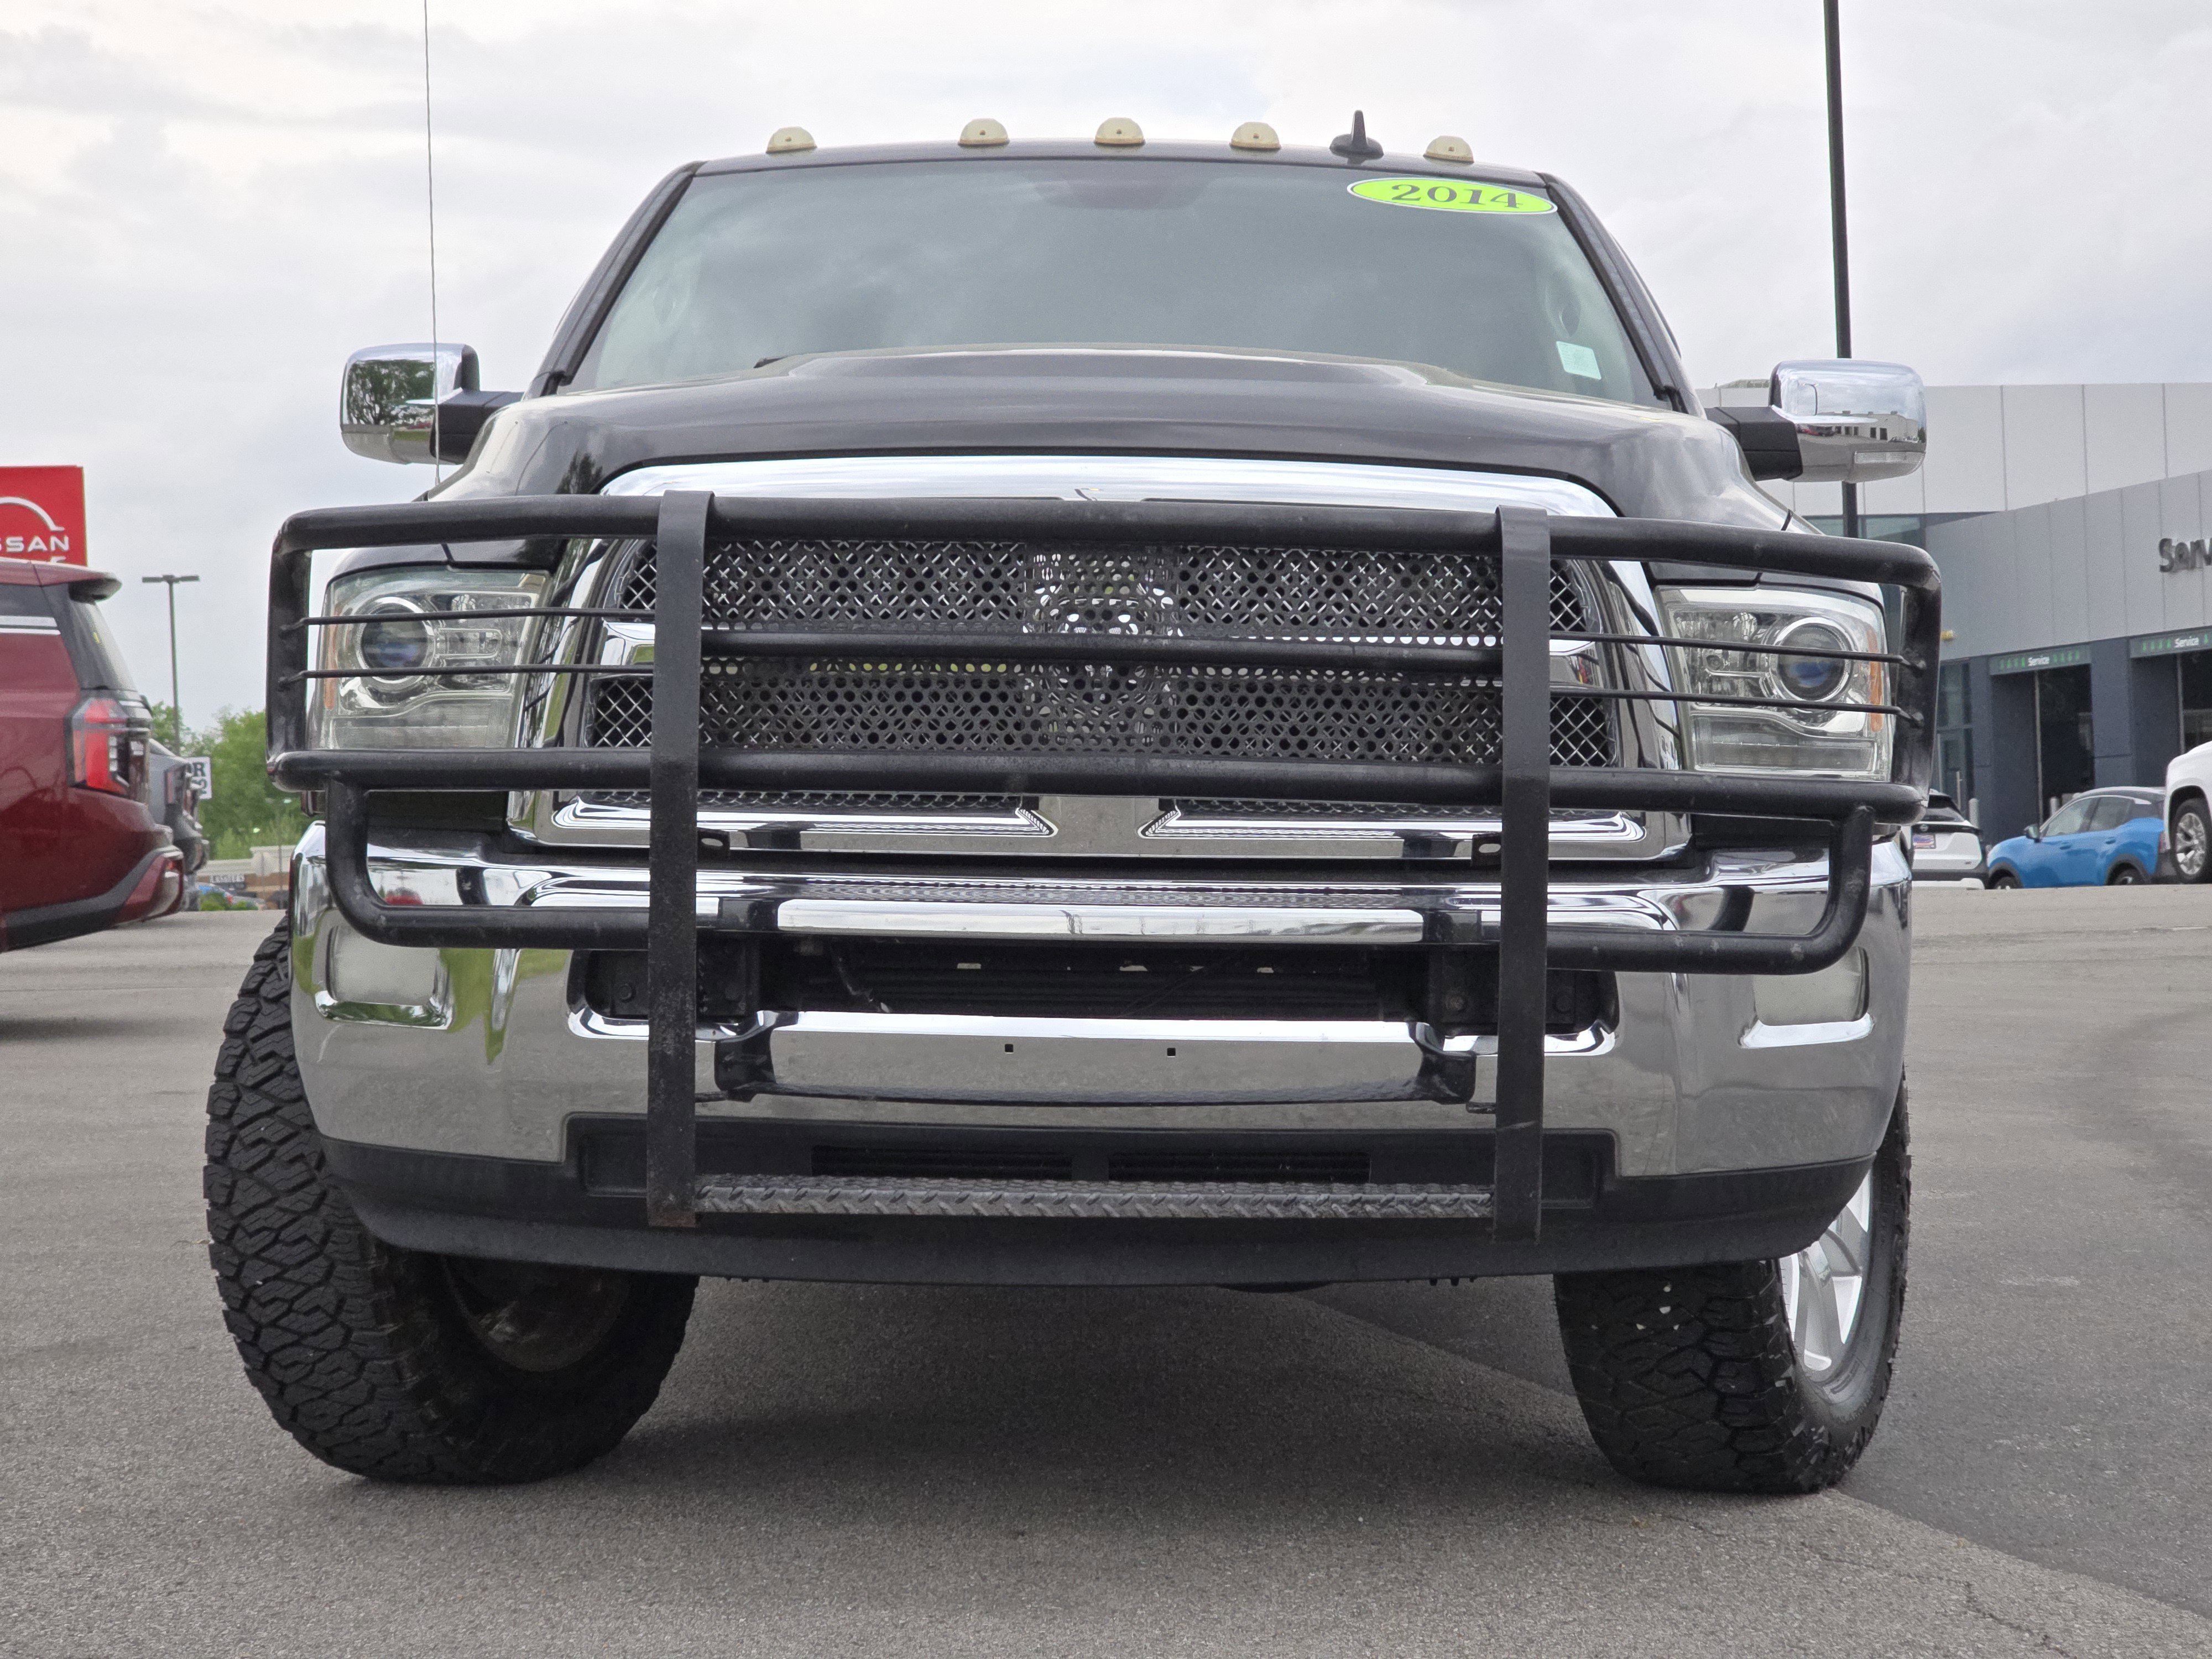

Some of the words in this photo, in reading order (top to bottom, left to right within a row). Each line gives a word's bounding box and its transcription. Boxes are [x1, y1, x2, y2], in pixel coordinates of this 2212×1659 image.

[1391, 184, 1523, 208] 2014
[0, 535, 69, 552] SAN
[2174, 636, 2199, 648] Service
[2028, 655, 2049, 666] Service
